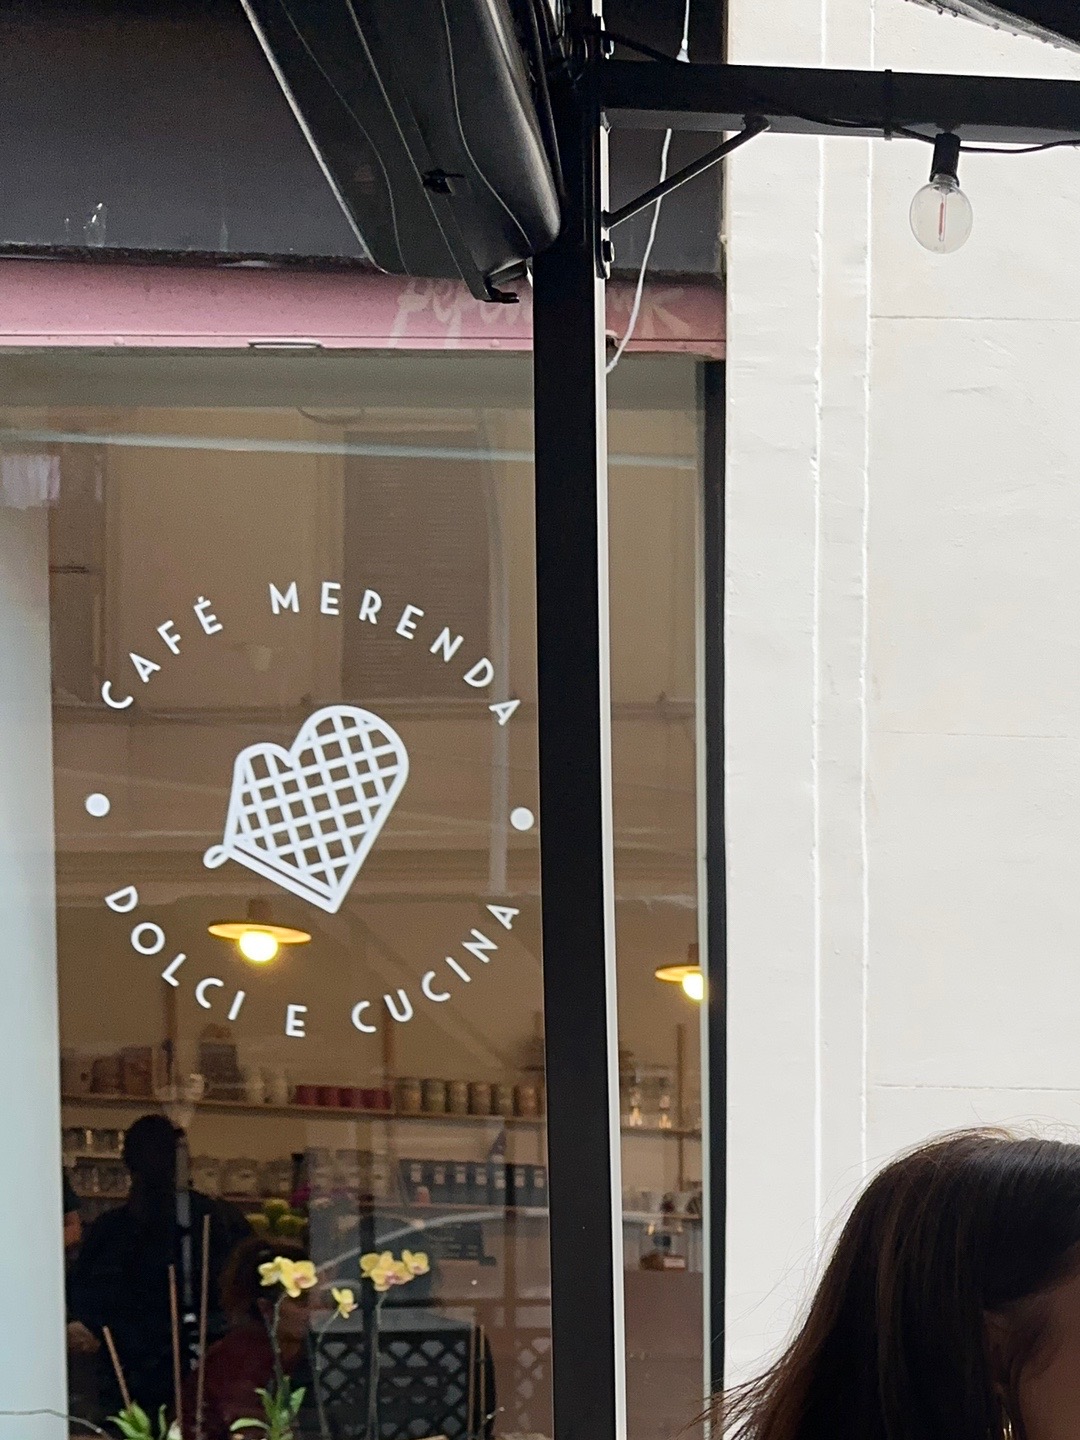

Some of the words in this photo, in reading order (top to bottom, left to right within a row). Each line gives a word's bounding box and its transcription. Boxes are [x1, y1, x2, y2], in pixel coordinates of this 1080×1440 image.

[101, 595, 224, 710] CAFÉ
[269, 580, 521, 726] MERENDA
[104, 885, 246, 1021] DOLCI
[286, 1003, 308, 1038] E
[351, 903, 520, 1034] CUCINA
